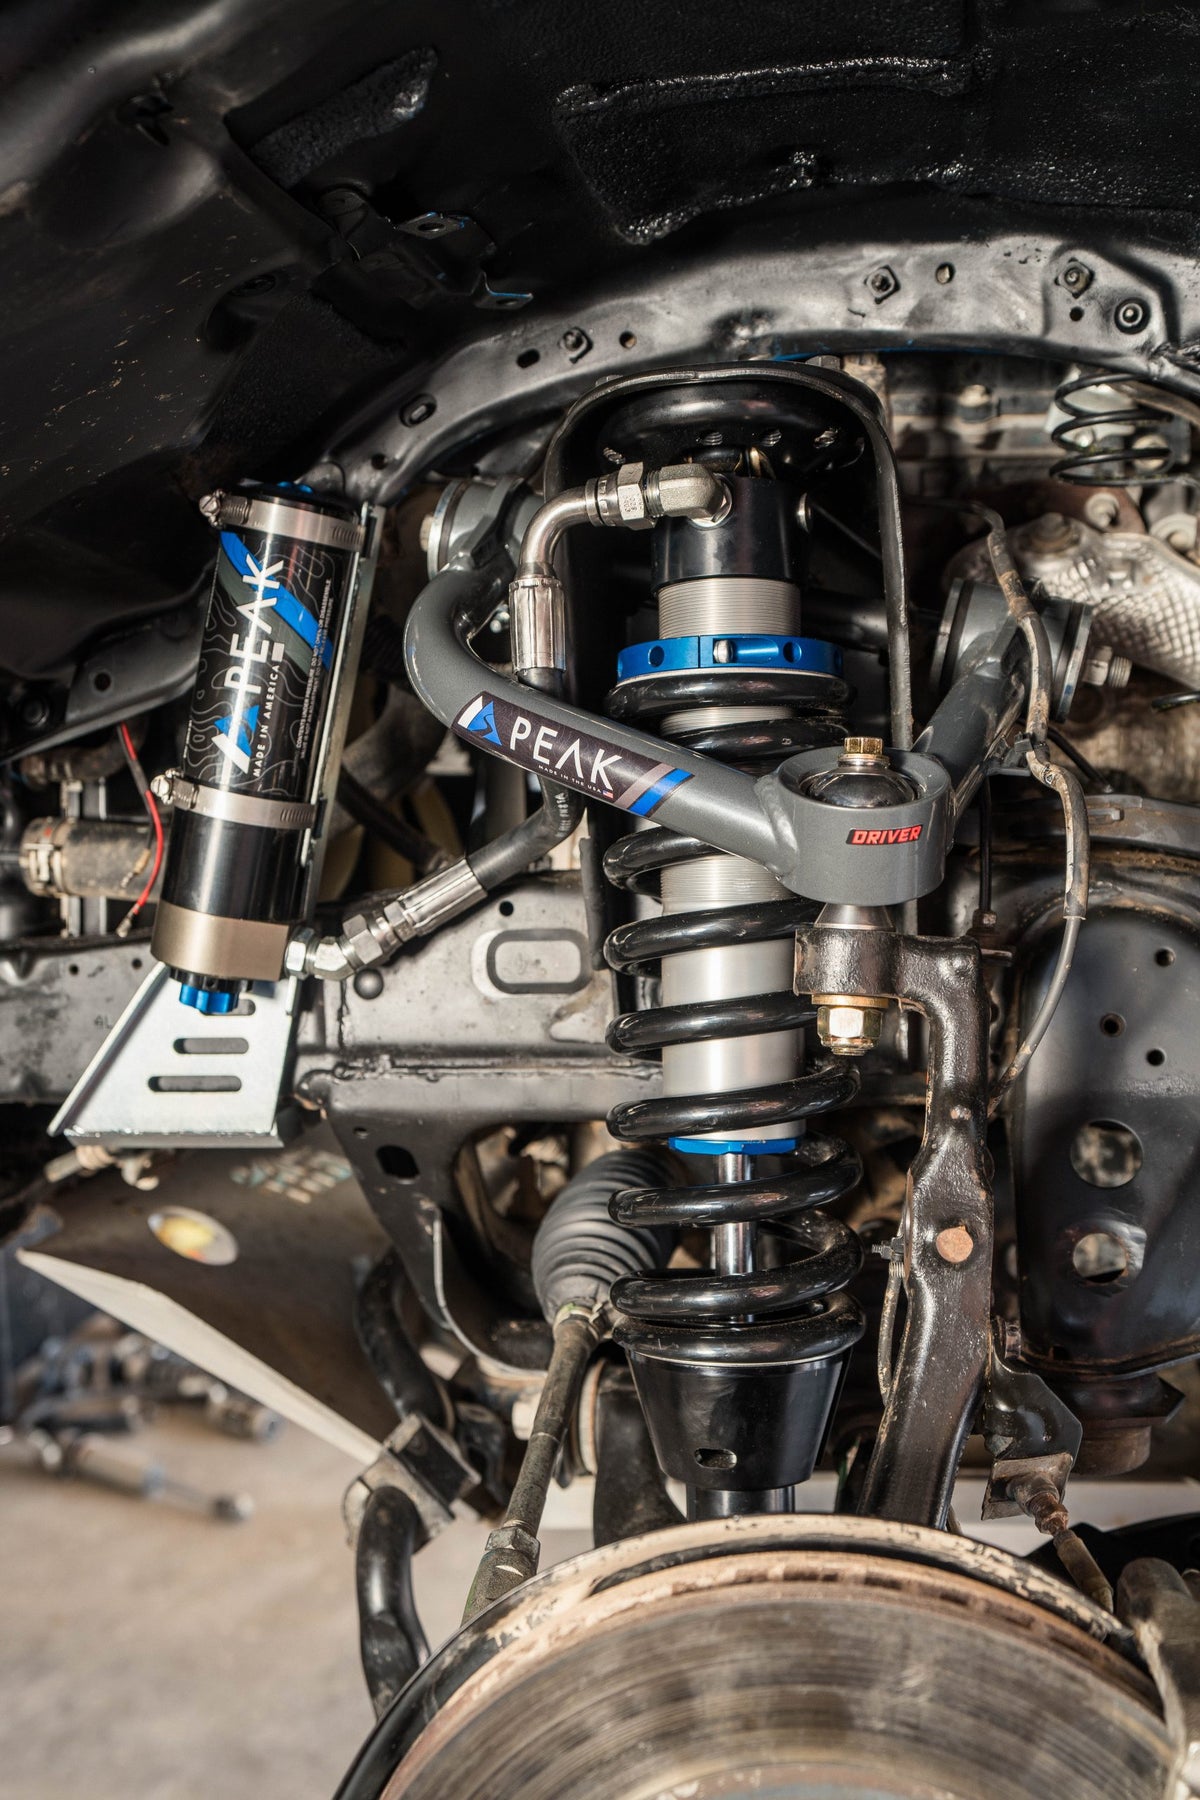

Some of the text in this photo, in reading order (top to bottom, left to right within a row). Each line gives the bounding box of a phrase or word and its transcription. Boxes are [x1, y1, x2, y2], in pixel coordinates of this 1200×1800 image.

[224, 553, 284, 694] PEAK
[301, 698, 309, 717] UNDER
[314, 627, 322, 644] OPEN
[253, 665, 280, 778] MADE IN AMERICA
[509, 716, 622, 791] PEAK
[538, 764, 557, 776] MADE
[571, 778, 584, 786] THE
[587, 784, 602, 793] USA
[851, 825, 921, 844] DRIVER
